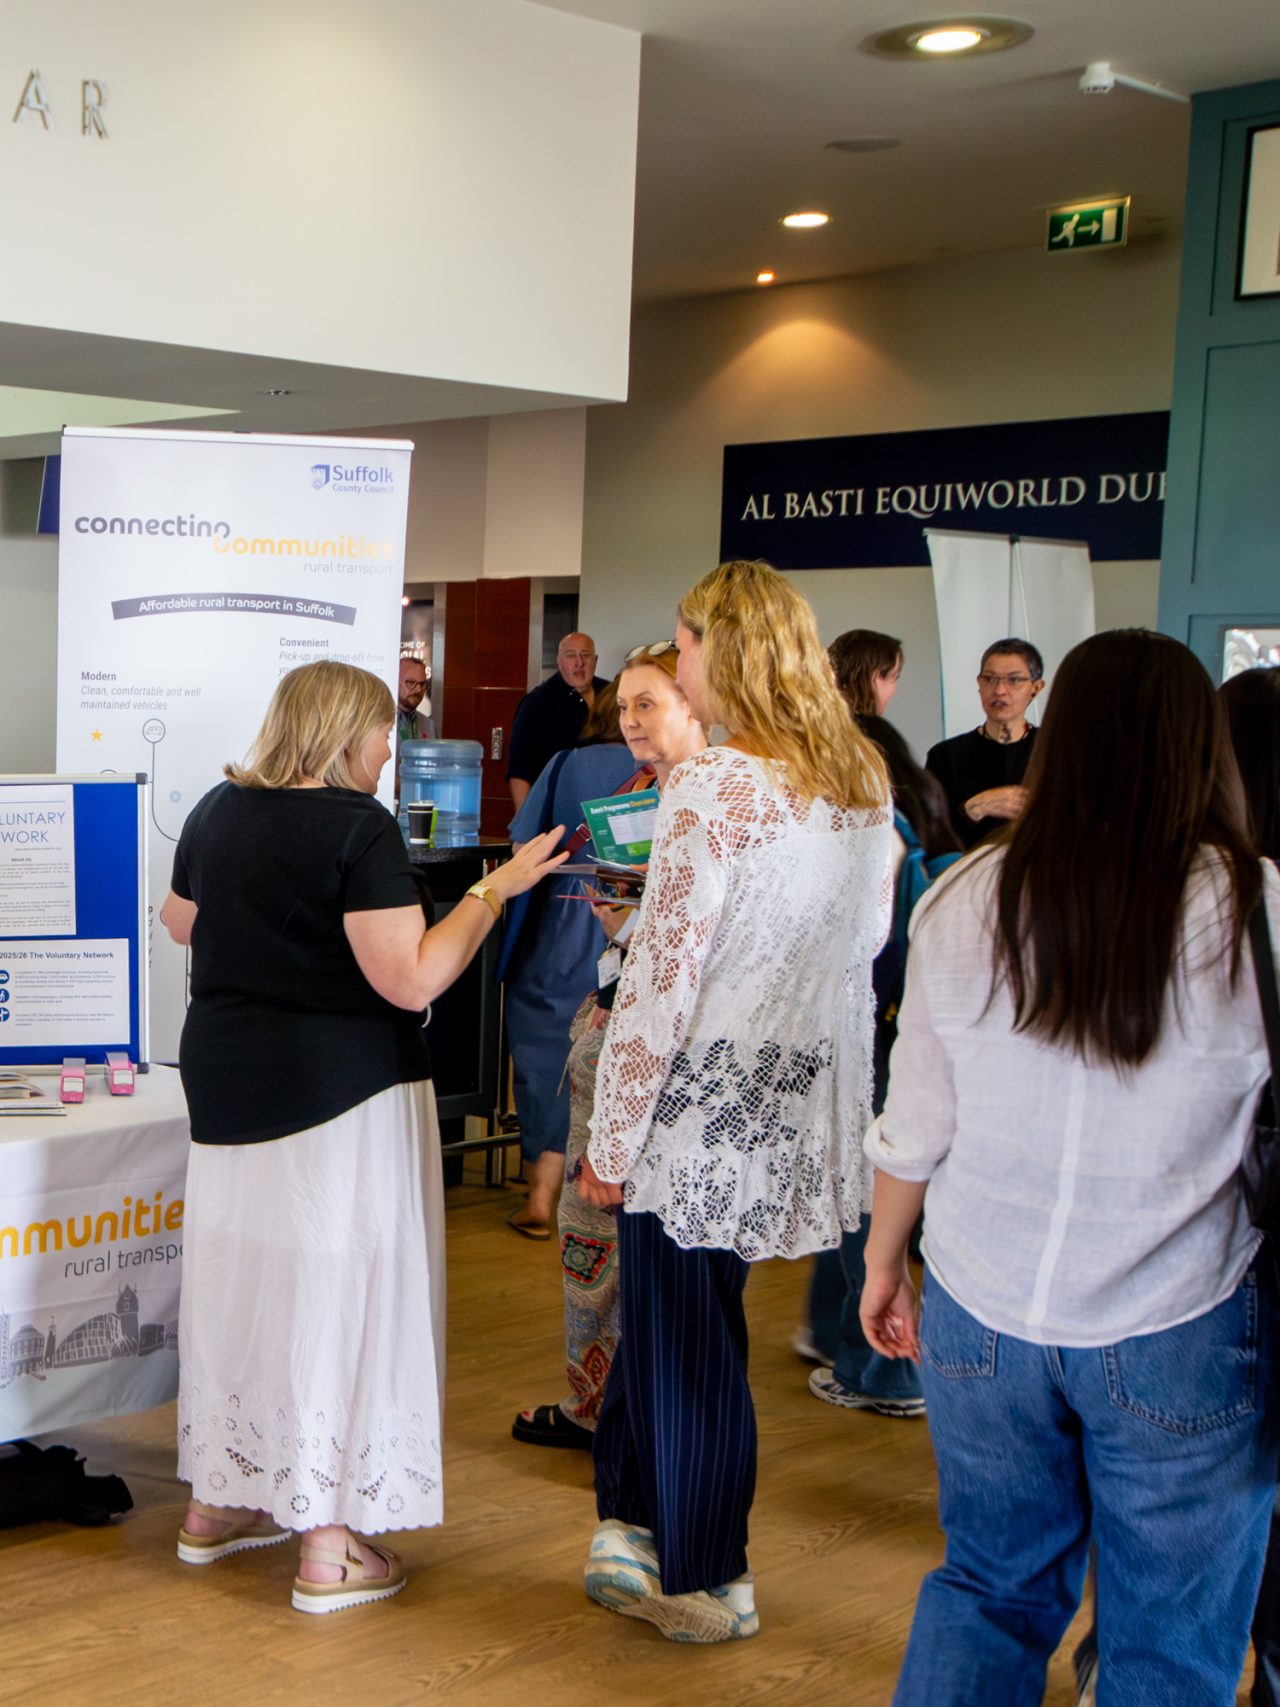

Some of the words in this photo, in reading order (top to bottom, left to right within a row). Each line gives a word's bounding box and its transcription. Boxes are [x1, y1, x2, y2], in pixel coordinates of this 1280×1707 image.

[333, 465, 393, 483] Suffolk
[332, 483, 362, 495] County
[740, 494, 775, 521] AL
[784, 488, 864, 518] BASTI
[875, 476, 1086, 519] EQUIWORLD
[74, 513, 231, 539] connecting
[304, 561, 333, 573] rural
[337, 562, 395, 576] transport
[139, 597, 198, 613] Affordable
[199, 596, 225, 608] rural
[227, 597, 281, 610] transport
[283, 600, 293, 611] in
[295, 602, 335, 618] Suffolk
[279, 637, 329, 648] Convenient
[279, 650, 311, 662] Pick-up
[81, 671, 117, 681] Modern
[81, 685, 109, 697] Clean,
[111, 686, 165, 697] comfortable
[166, 687, 182, 697] and
[184, 687, 202, 697] well
[80, 700, 131, 710] maintained
[132, 701, 168, 710] vehicles
[45, 952, 81, 961] Voluntary
[83, 951, 114, 959] Network
[64, 1250, 111, 1277] rural
[116, 1243, 183, 1270] transp
